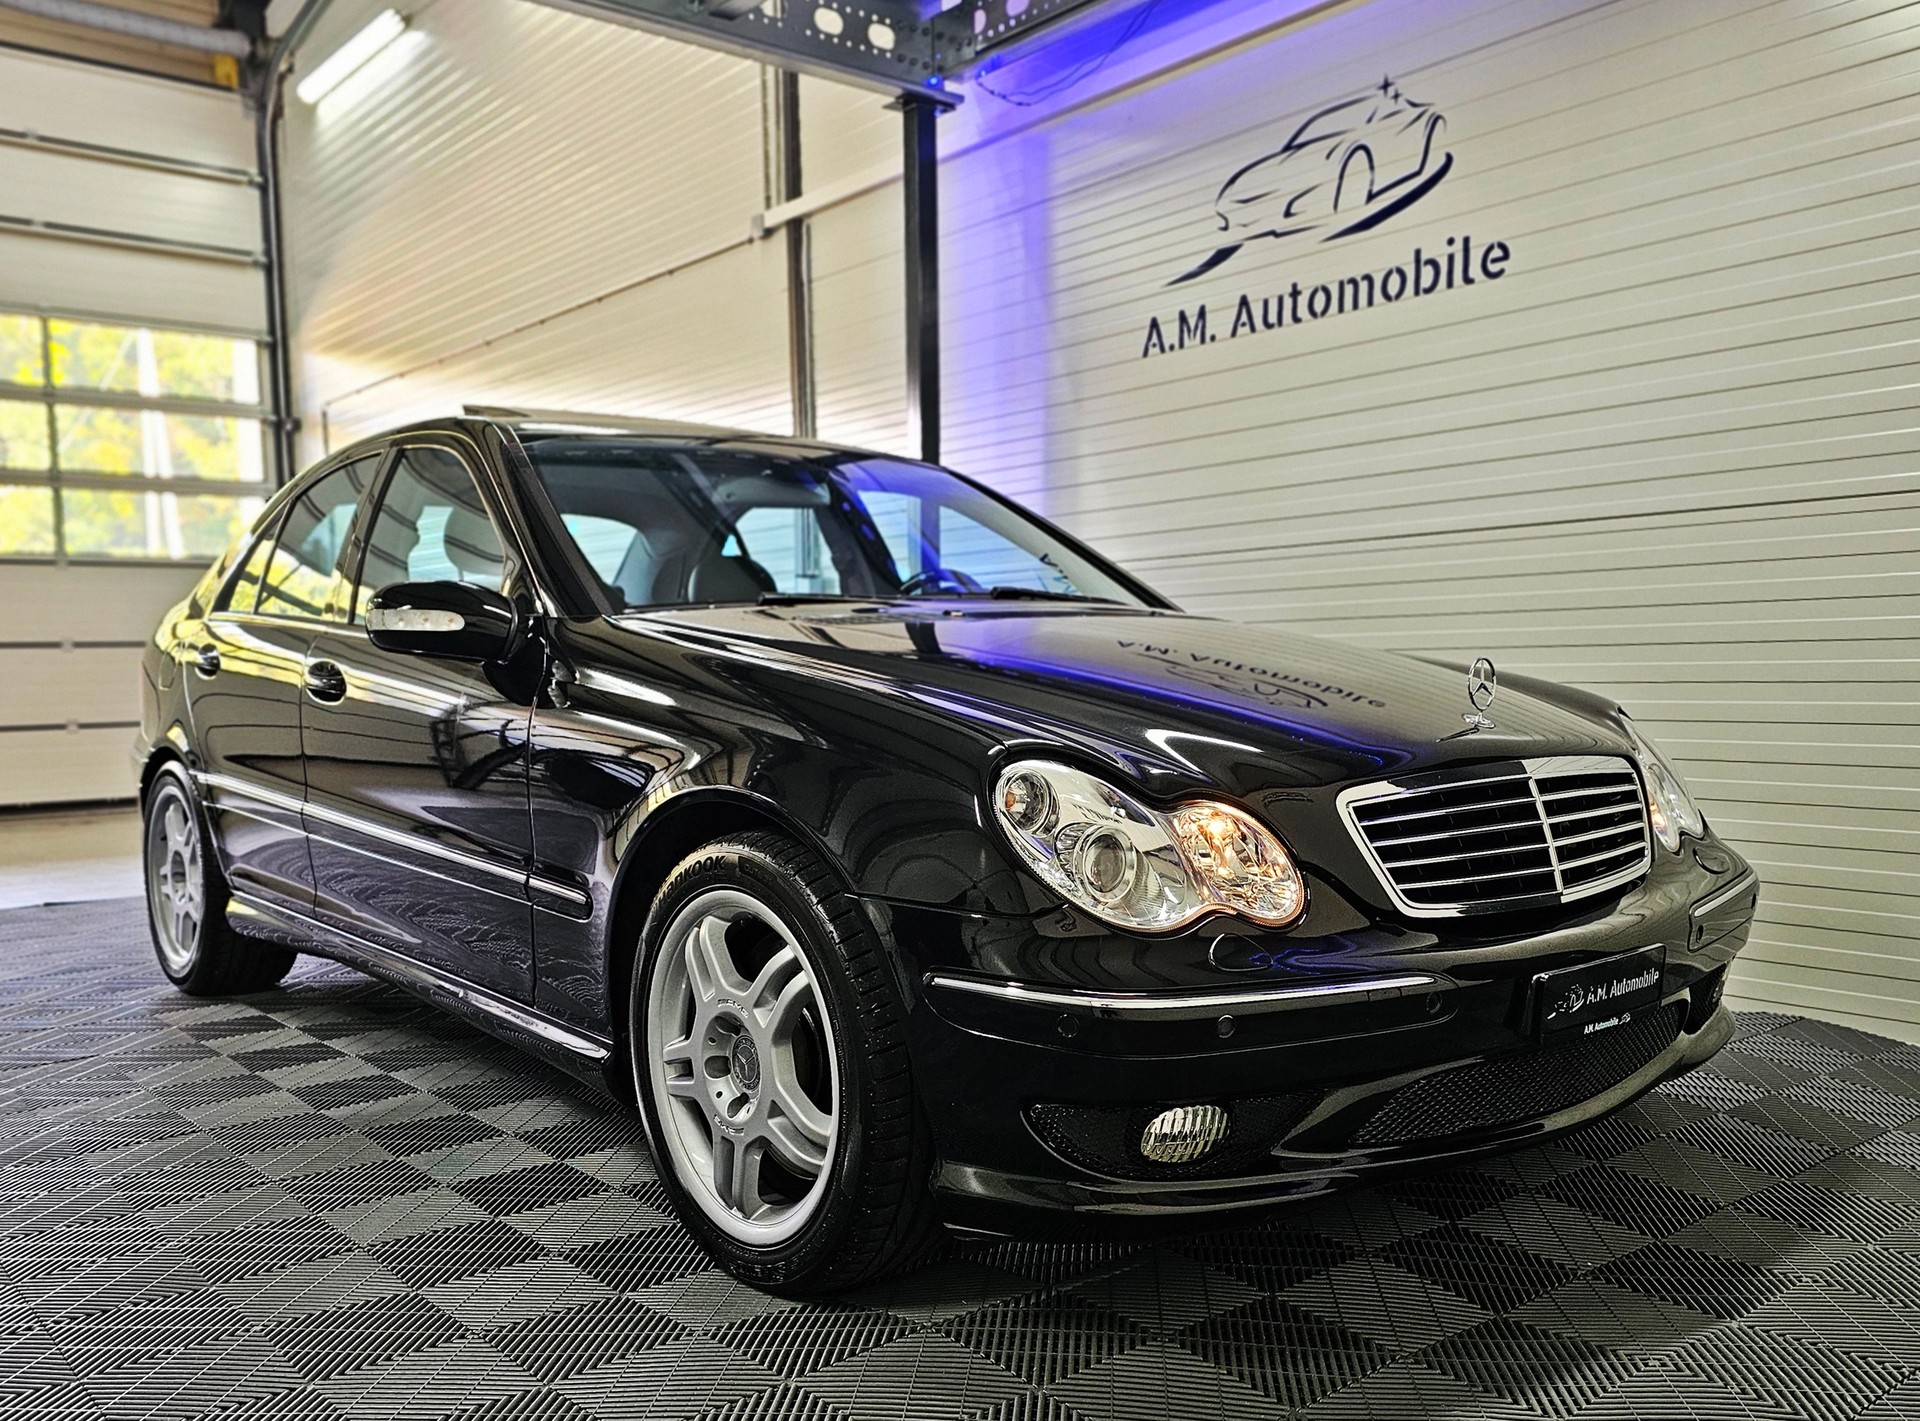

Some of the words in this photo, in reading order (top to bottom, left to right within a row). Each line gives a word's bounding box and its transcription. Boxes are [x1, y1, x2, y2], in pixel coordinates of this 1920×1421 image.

[1141, 303, 1217, 359] A.M.
[1230, 235, 1511, 338] Automobile
[1586, 983, 1608, 1005] A.M.
[1609, 967, 1659, 998] Automobile
